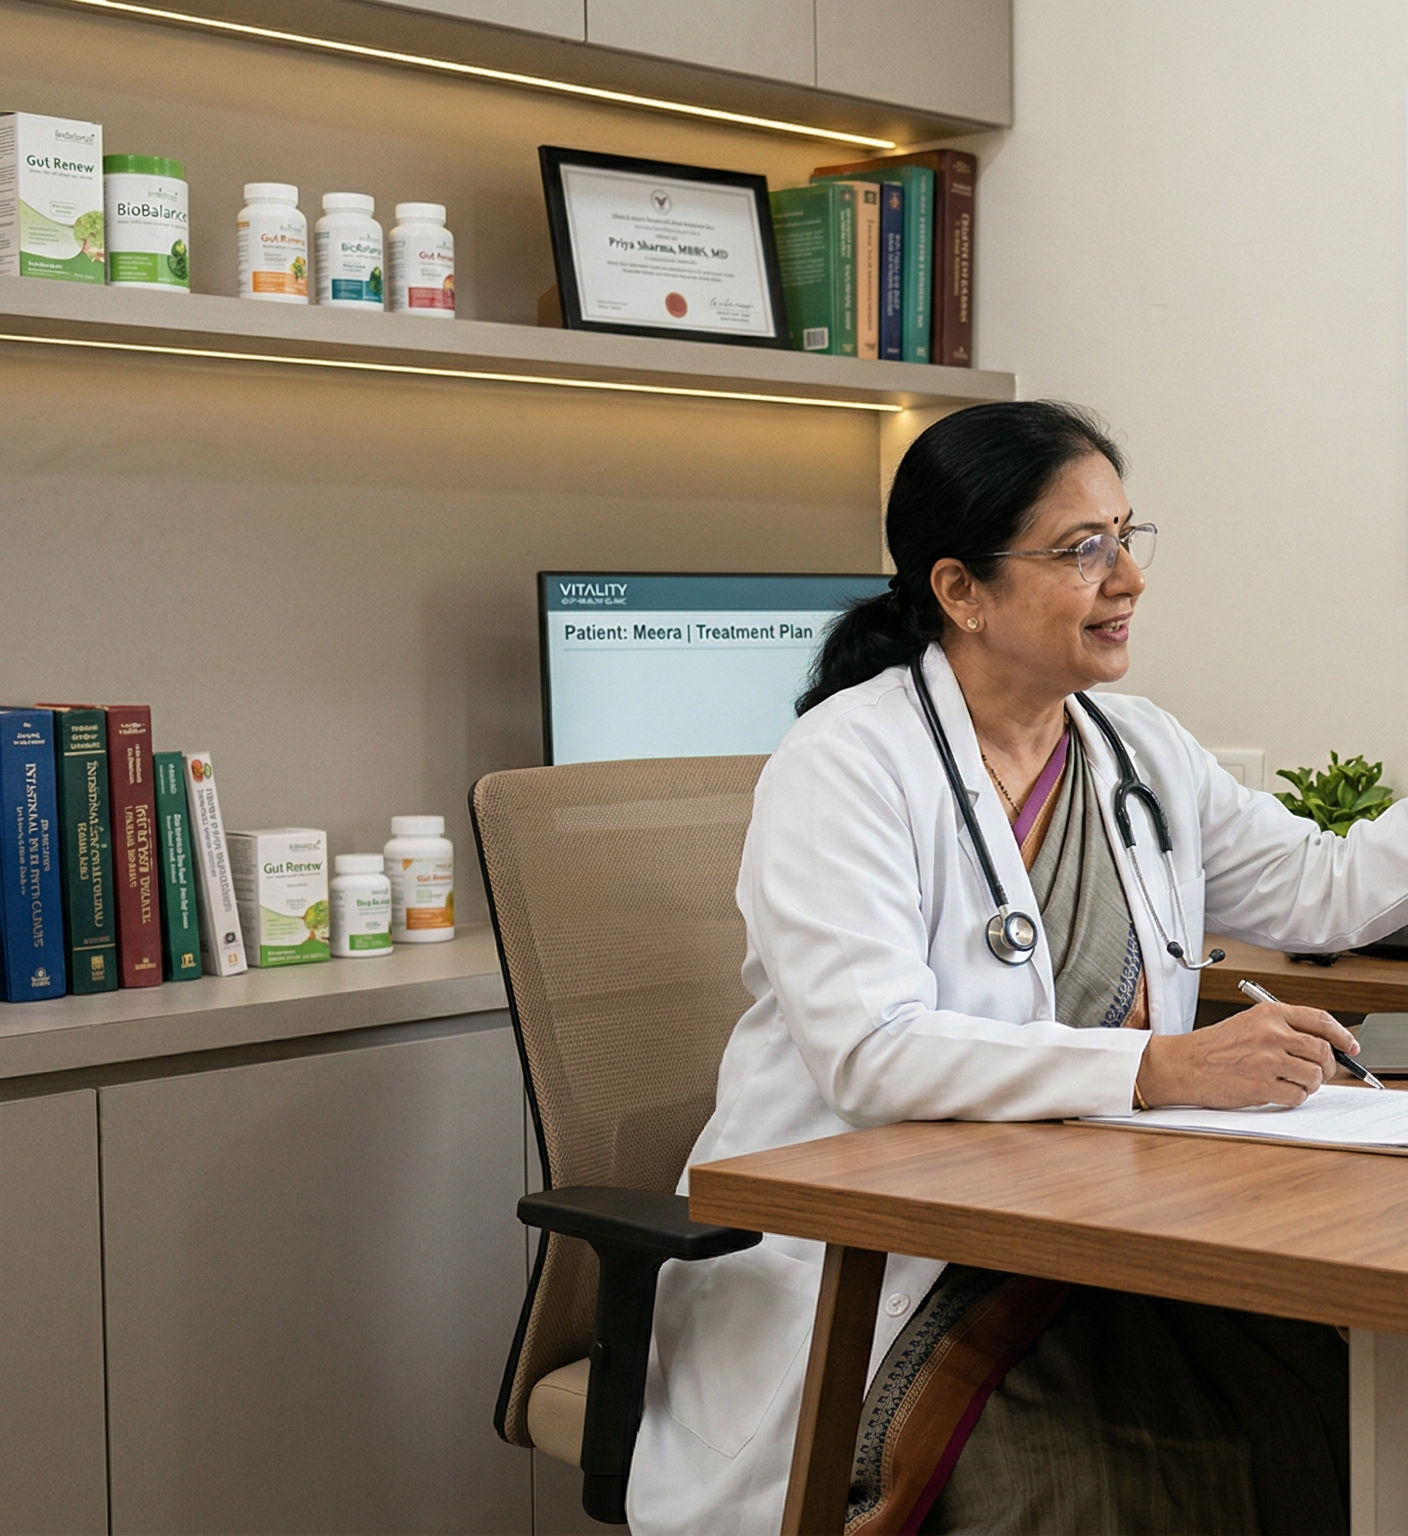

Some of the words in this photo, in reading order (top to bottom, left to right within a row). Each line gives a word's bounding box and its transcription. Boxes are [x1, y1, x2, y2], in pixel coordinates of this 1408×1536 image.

[27, 155, 51, 168] Gut
[54, 157, 95, 173] Renew
[117, 203, 187, 223] BioBalance
[609, 237, 635, 251] Priya
[711, 248, 729, 260] MD
[560, 583, 628, 596] VITALITY
[565, 625, 627, 640] Patient:
[634, 625, 681, 639] Meera
[696, 624, 775, 639] Treatment
[780, 624, 812, 638] Plan
[264, 862, 284, 875] Gut
